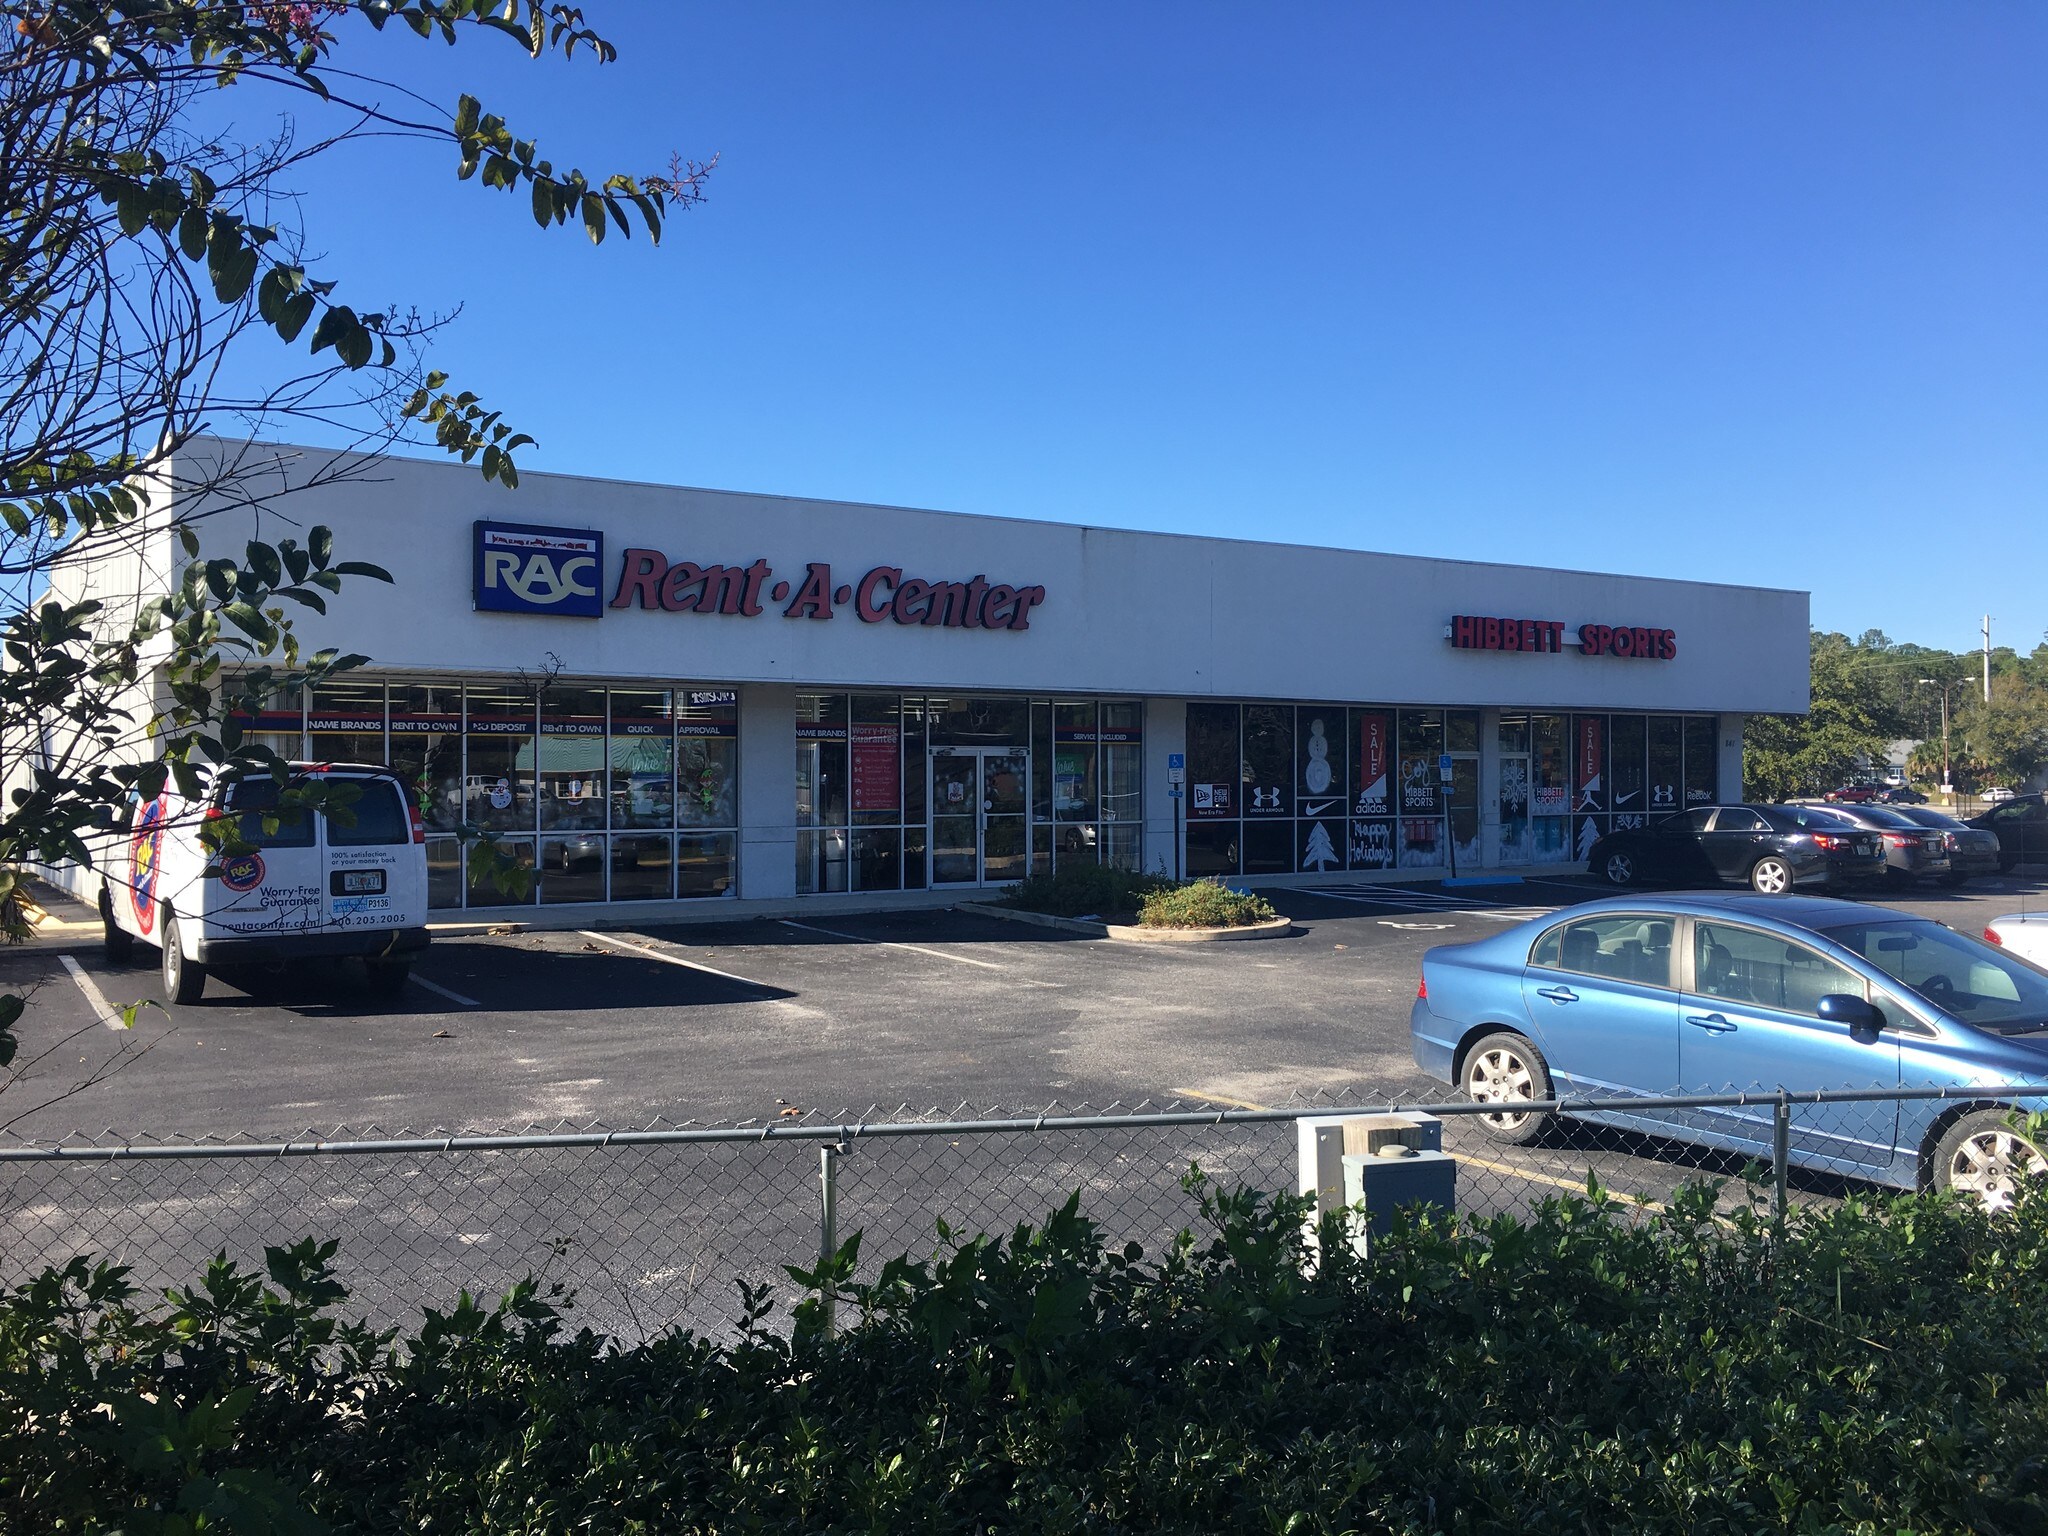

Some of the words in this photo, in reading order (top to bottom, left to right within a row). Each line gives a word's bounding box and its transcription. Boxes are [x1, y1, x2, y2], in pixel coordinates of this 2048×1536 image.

[485, 550, 595, 604] RAC
[1452, 615, 1565, 653] HIBBETT
[1579, 623, 1676, 660] SPORTS
[308, 720, 340, 730] NAME
[340, 721, 382, 730] BRANDS
[392, 722, 416, 730] RENT
[416, 722, 430, 730] TO
[431, 722, 457, 731] OWN
[490, 723, 527, 732] DEPOSIT
[542, 724, 564, 732] RENT
[565, 725, 577, 733] TO
[578, 725, 602, 733] OWN
[627, 725, 654, 734] QUICK
[678, 726, 720, 734] APPROVAL
[795, 729, 816, 737] NAME
[817, 729, 847, 738] BRANDS
[852, 726, 898, 735] Worry-Free
[852, 735, 898, 744] Guarantee
[1370, 723, 1378, 775] SALE
[1213, 788, 1228, 796] NEW
[1406, 787, 1433, 797] HIBBETT
[1536, 787, 1562, 797] HIBBETT
[1213, 795, 1228, 803] ERA
[1405, 797, 1434, 807] SPORTS
[1536, 796, 1562, 806] SPORTS
[1355, 803, 1387, 814] adidas
[1352, 819, 1392, 844] Happy
[1350, 837, 1394, 869] Holidays
[380, 856, 397, 864] back
[230, 863, 254, 878] RAC
[260, 886, 320, 898] Worry-Free
[260, 897, 320, 908] Guarantee
[368, 898, 389, 909] P3136
